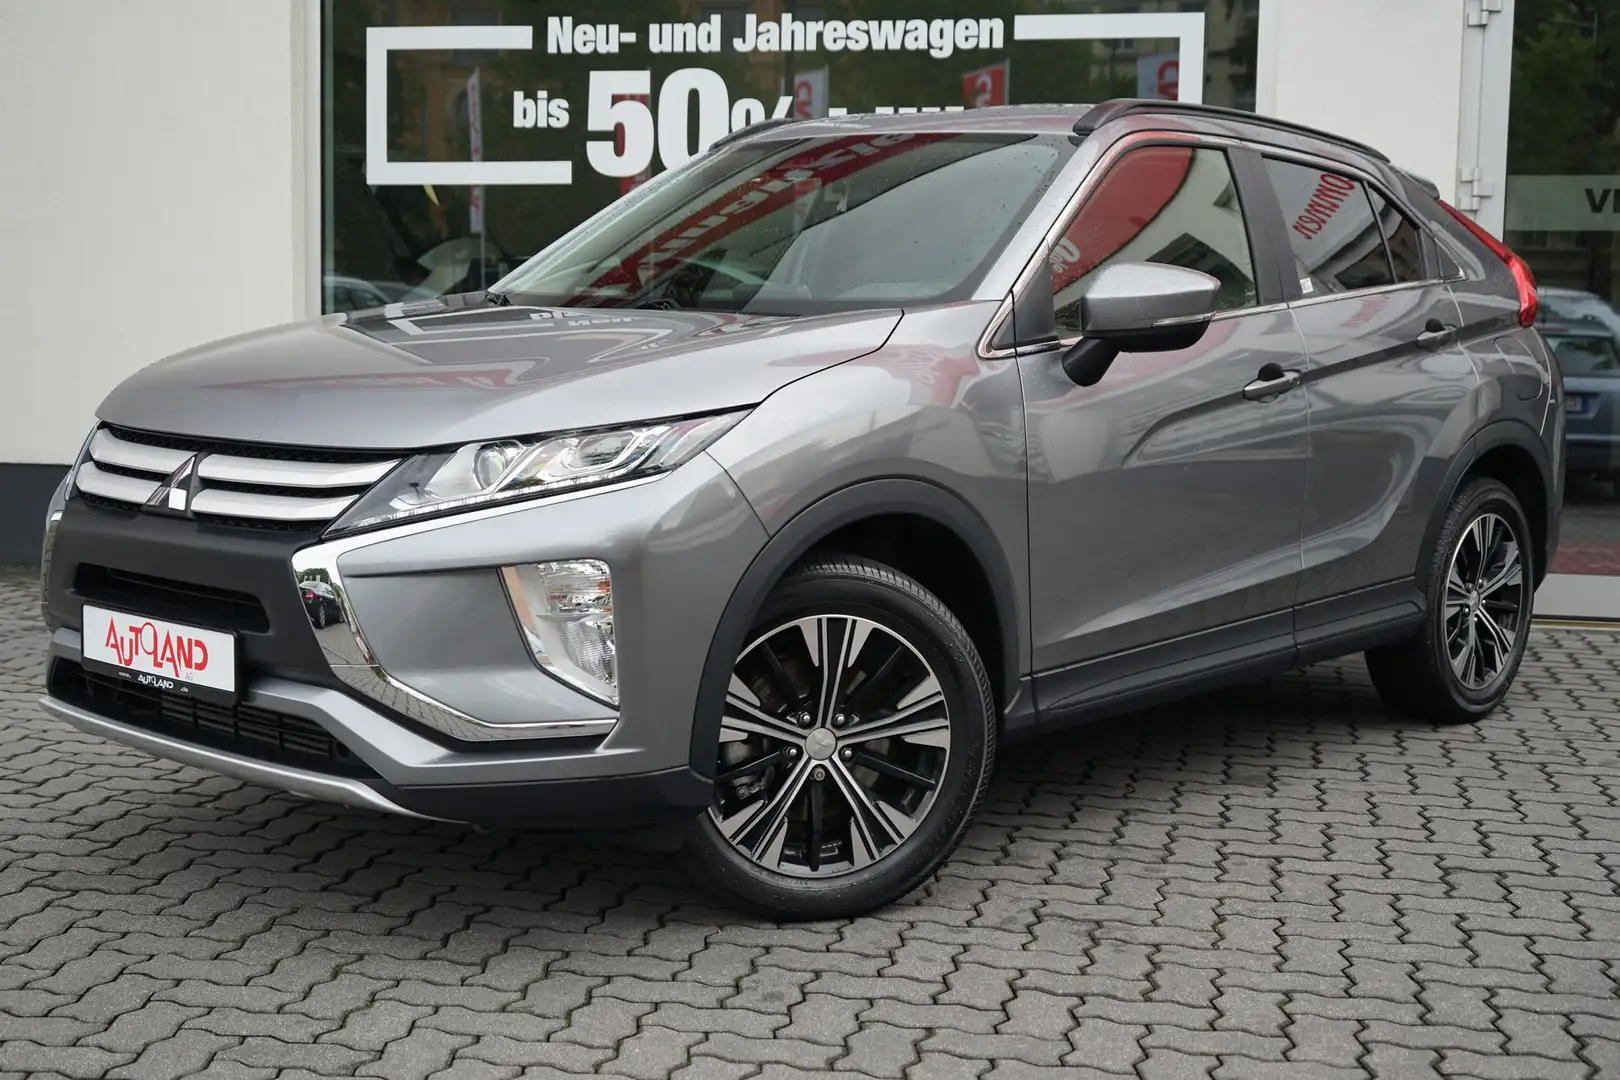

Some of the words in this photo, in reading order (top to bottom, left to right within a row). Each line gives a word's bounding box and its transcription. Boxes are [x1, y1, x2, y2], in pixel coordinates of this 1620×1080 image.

[547, 16, 637, 54] Neu-
[649, 14, 722, 53] und
[733, 13, 1005, 58] Jahreswagen
[513, 91, 570, 129] bis
[105, 617, 208, 678] AUTOLAND
[138, 674, 174, 689] AUTOLAND
